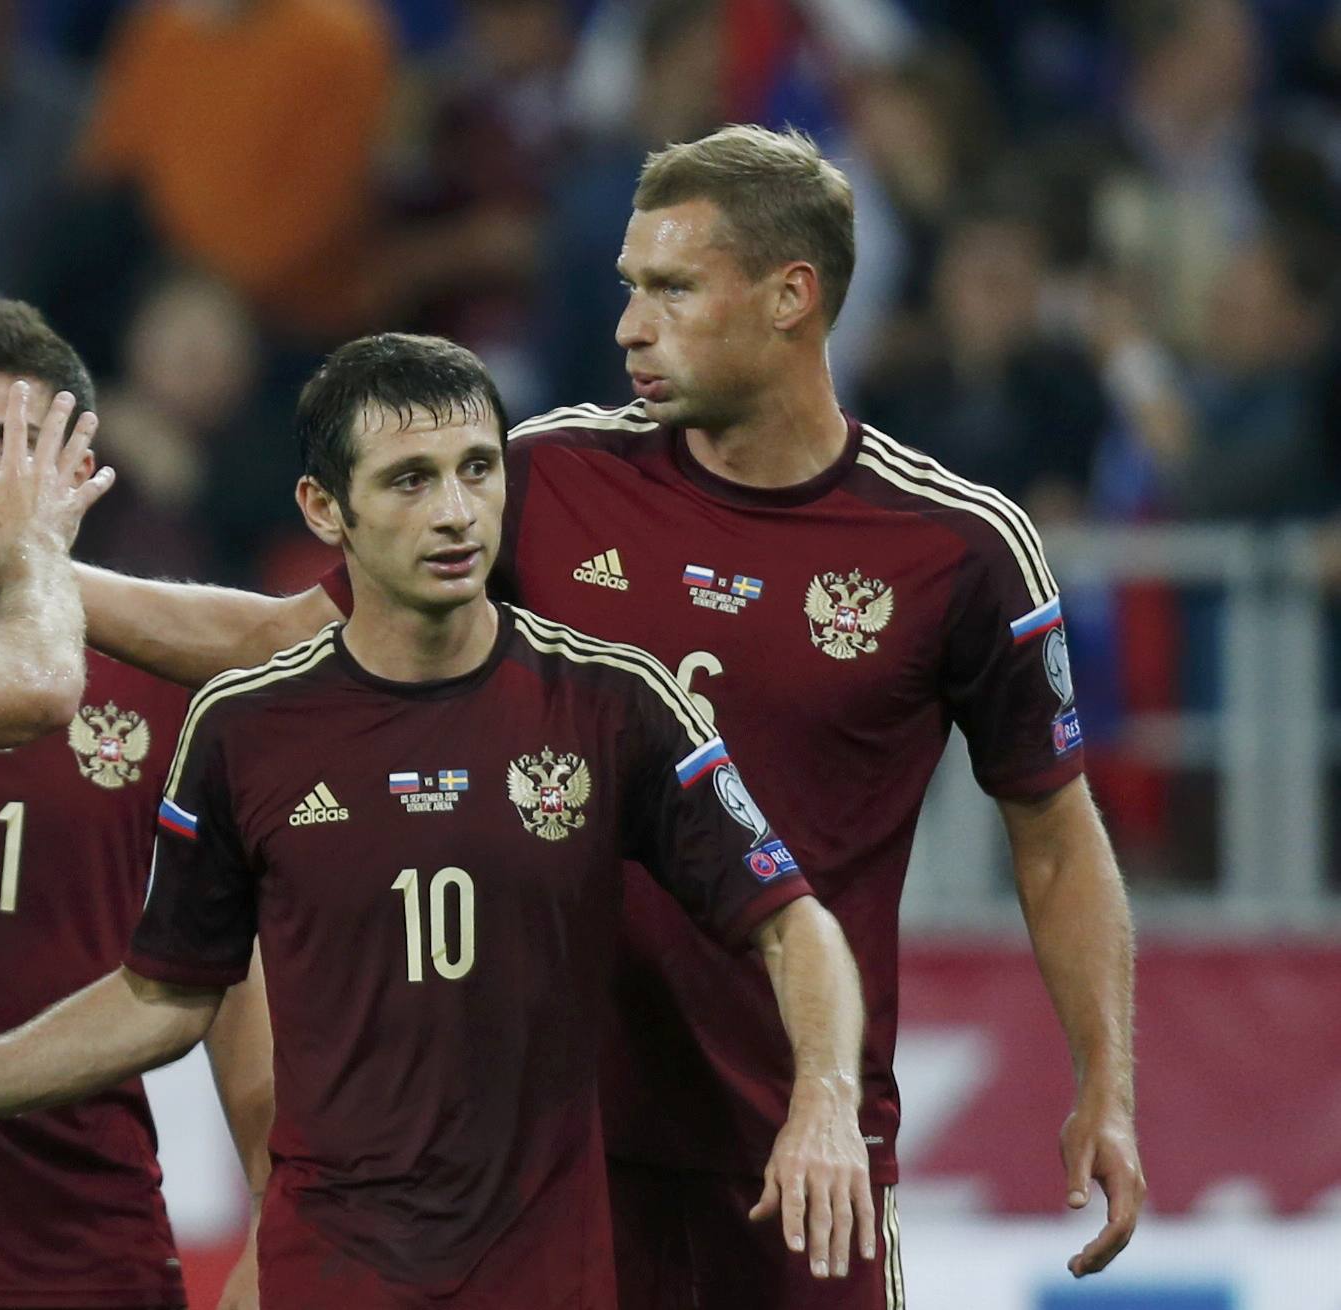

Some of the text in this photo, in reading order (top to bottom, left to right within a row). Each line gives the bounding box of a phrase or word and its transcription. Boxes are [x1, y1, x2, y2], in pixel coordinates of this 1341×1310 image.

[573, 568, 629, 590] adidas
[289, 807, 349, 826] adidas
[391, 867, 474, 982] 10
